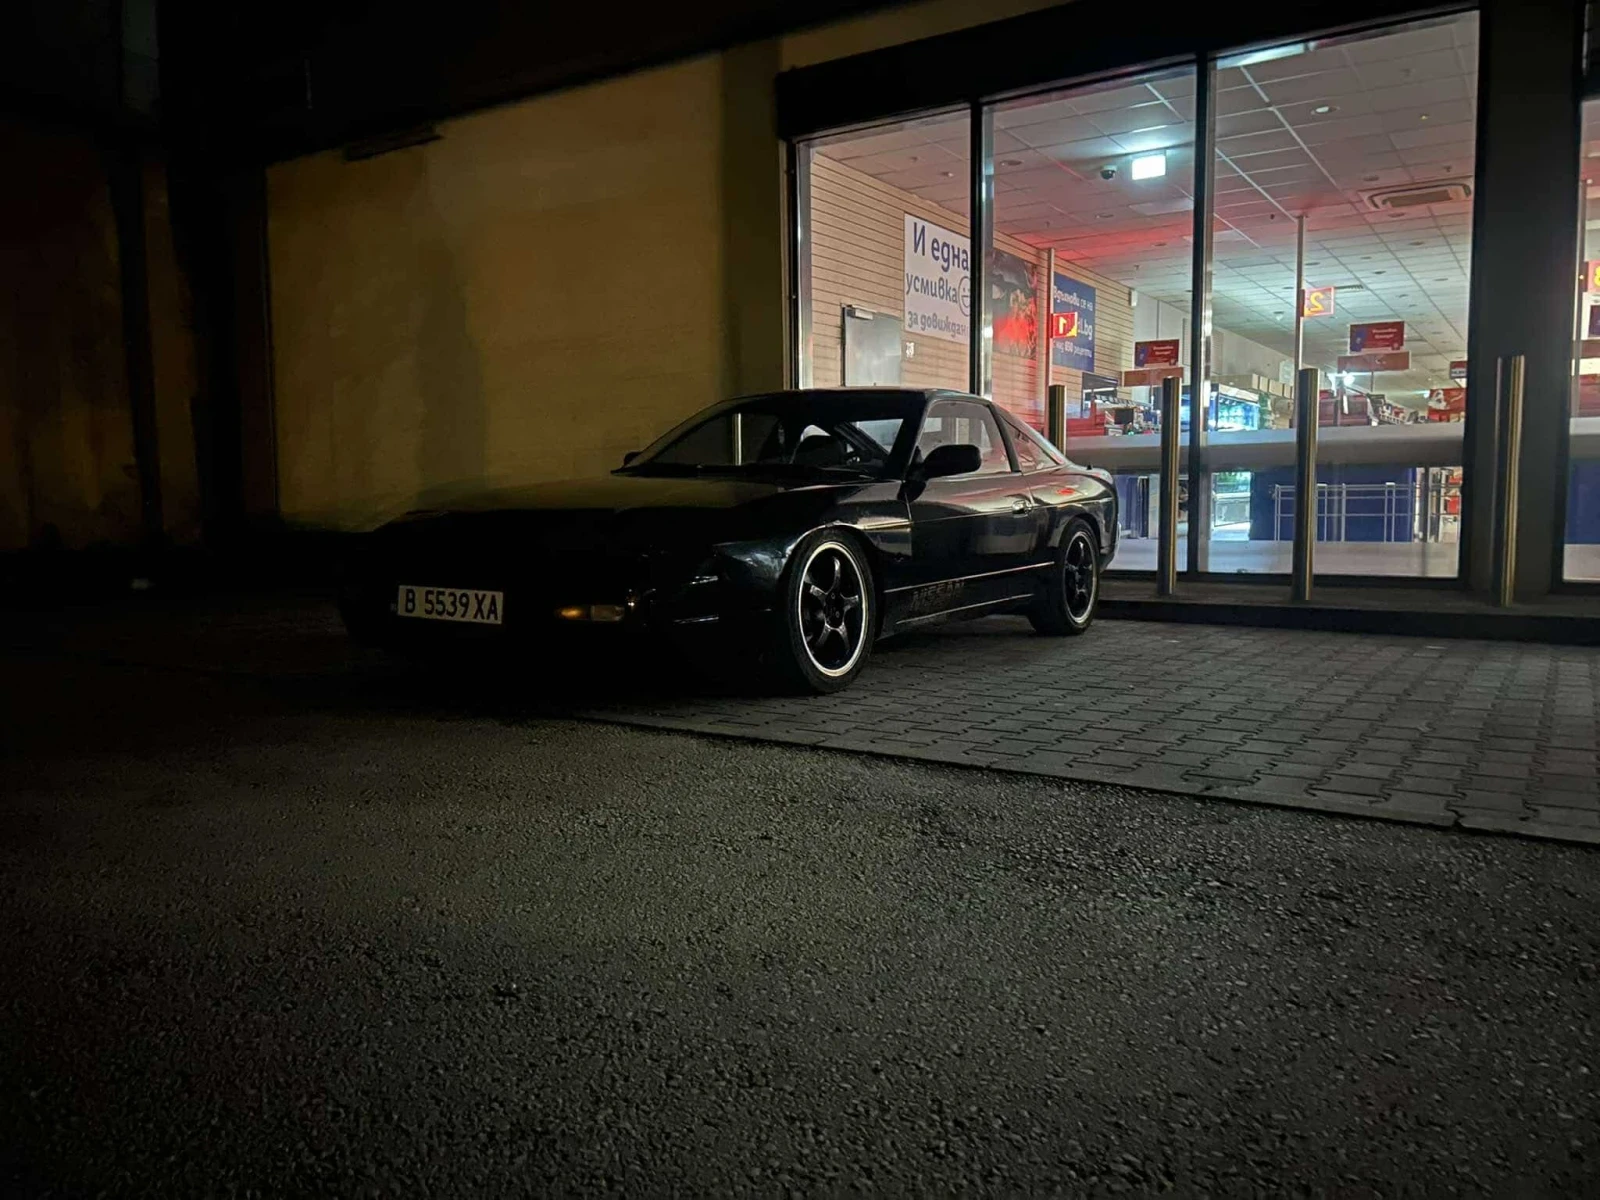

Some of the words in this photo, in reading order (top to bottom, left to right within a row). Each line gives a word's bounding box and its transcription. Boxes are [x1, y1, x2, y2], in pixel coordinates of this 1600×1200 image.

[913, 222, 925, 256] И
[931, 237, 969, 273] една
[906, 273, 958, 304] усмивка
[908, 311, 919, 329] за
[405, 588, 416, 613] B
[424, 589, 470, 618] 5539
[472, 592, 498, 620] XA
